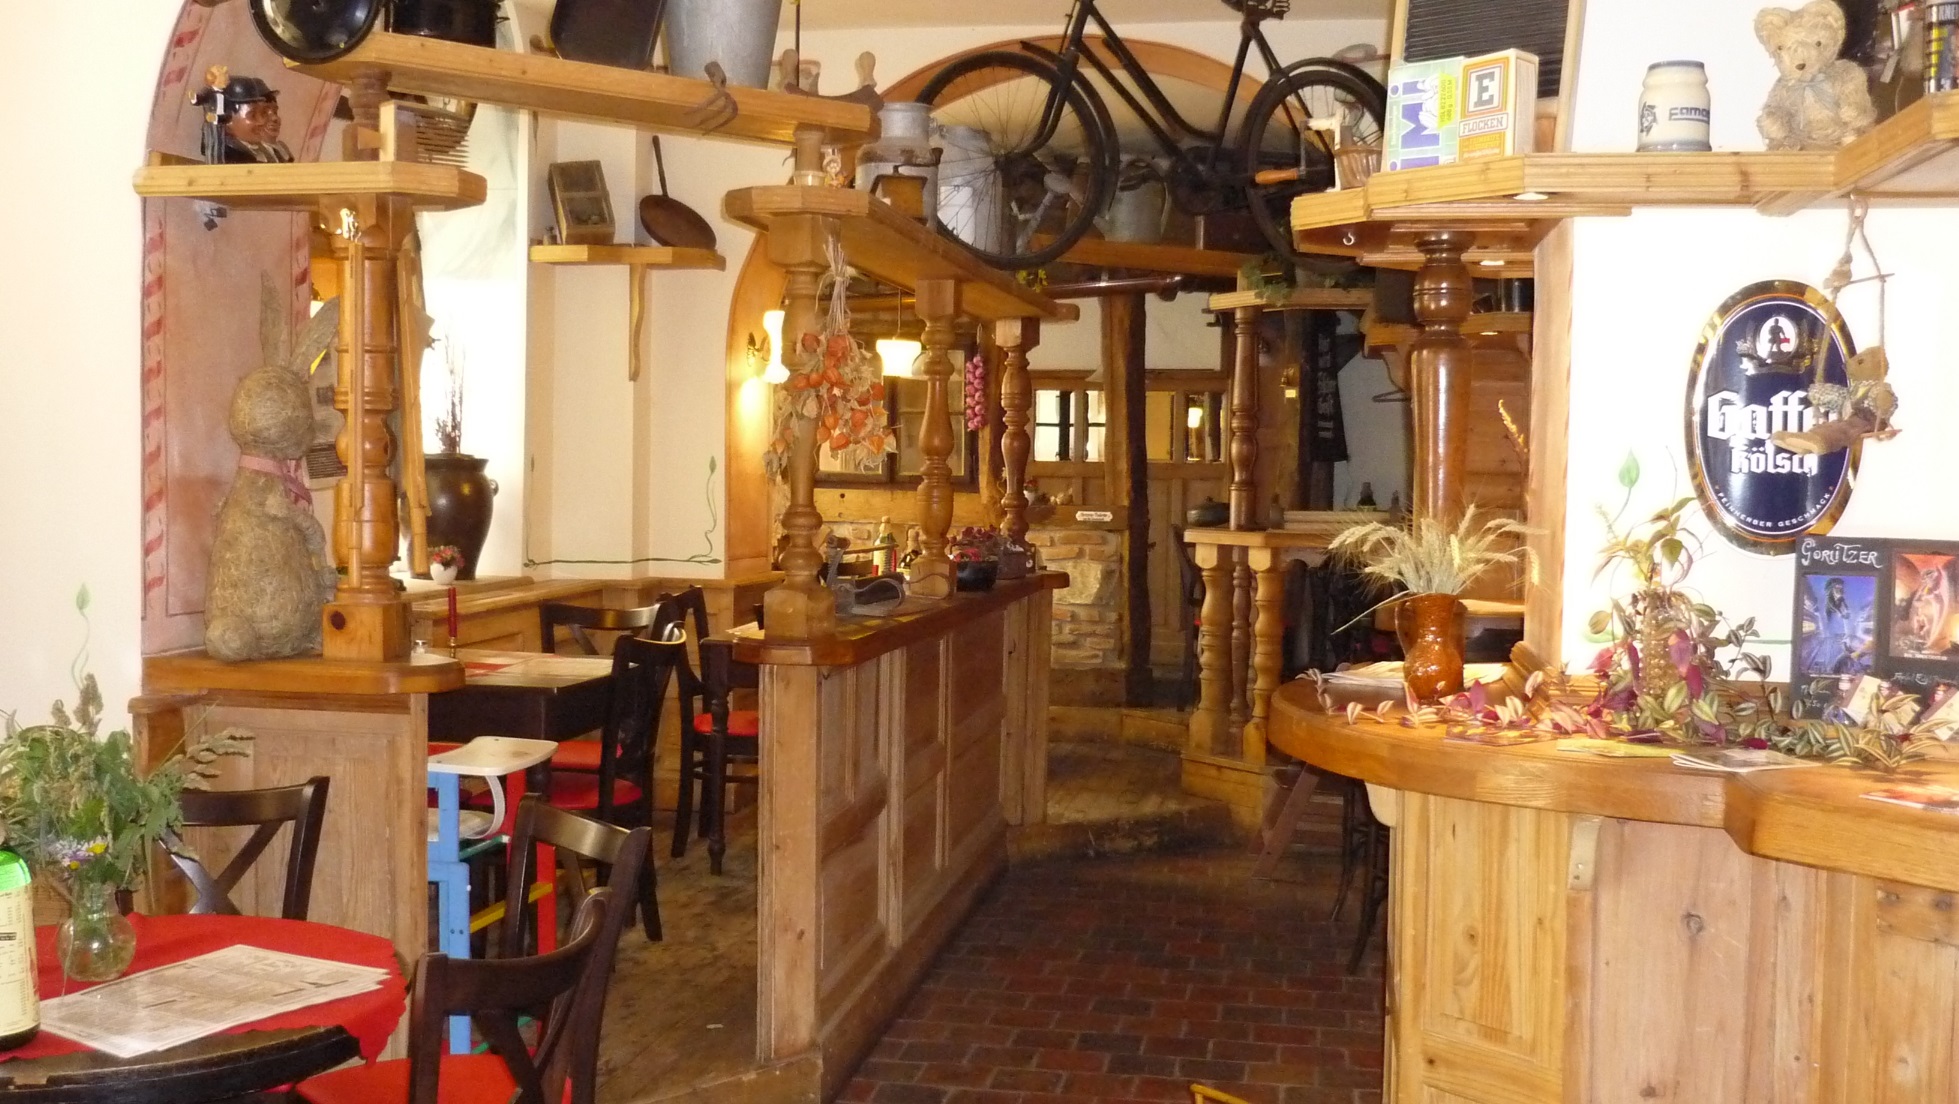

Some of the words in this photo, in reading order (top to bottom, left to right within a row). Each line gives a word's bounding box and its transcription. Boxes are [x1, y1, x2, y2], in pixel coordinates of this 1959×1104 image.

[1473, 71, 1496, 108] E
[1462, 116, 1504, 135] FLOCKEN
[1717, 492, 1773, 528] FEINHERBER
[1777, 492, 1831, 528] GESCHMACK
